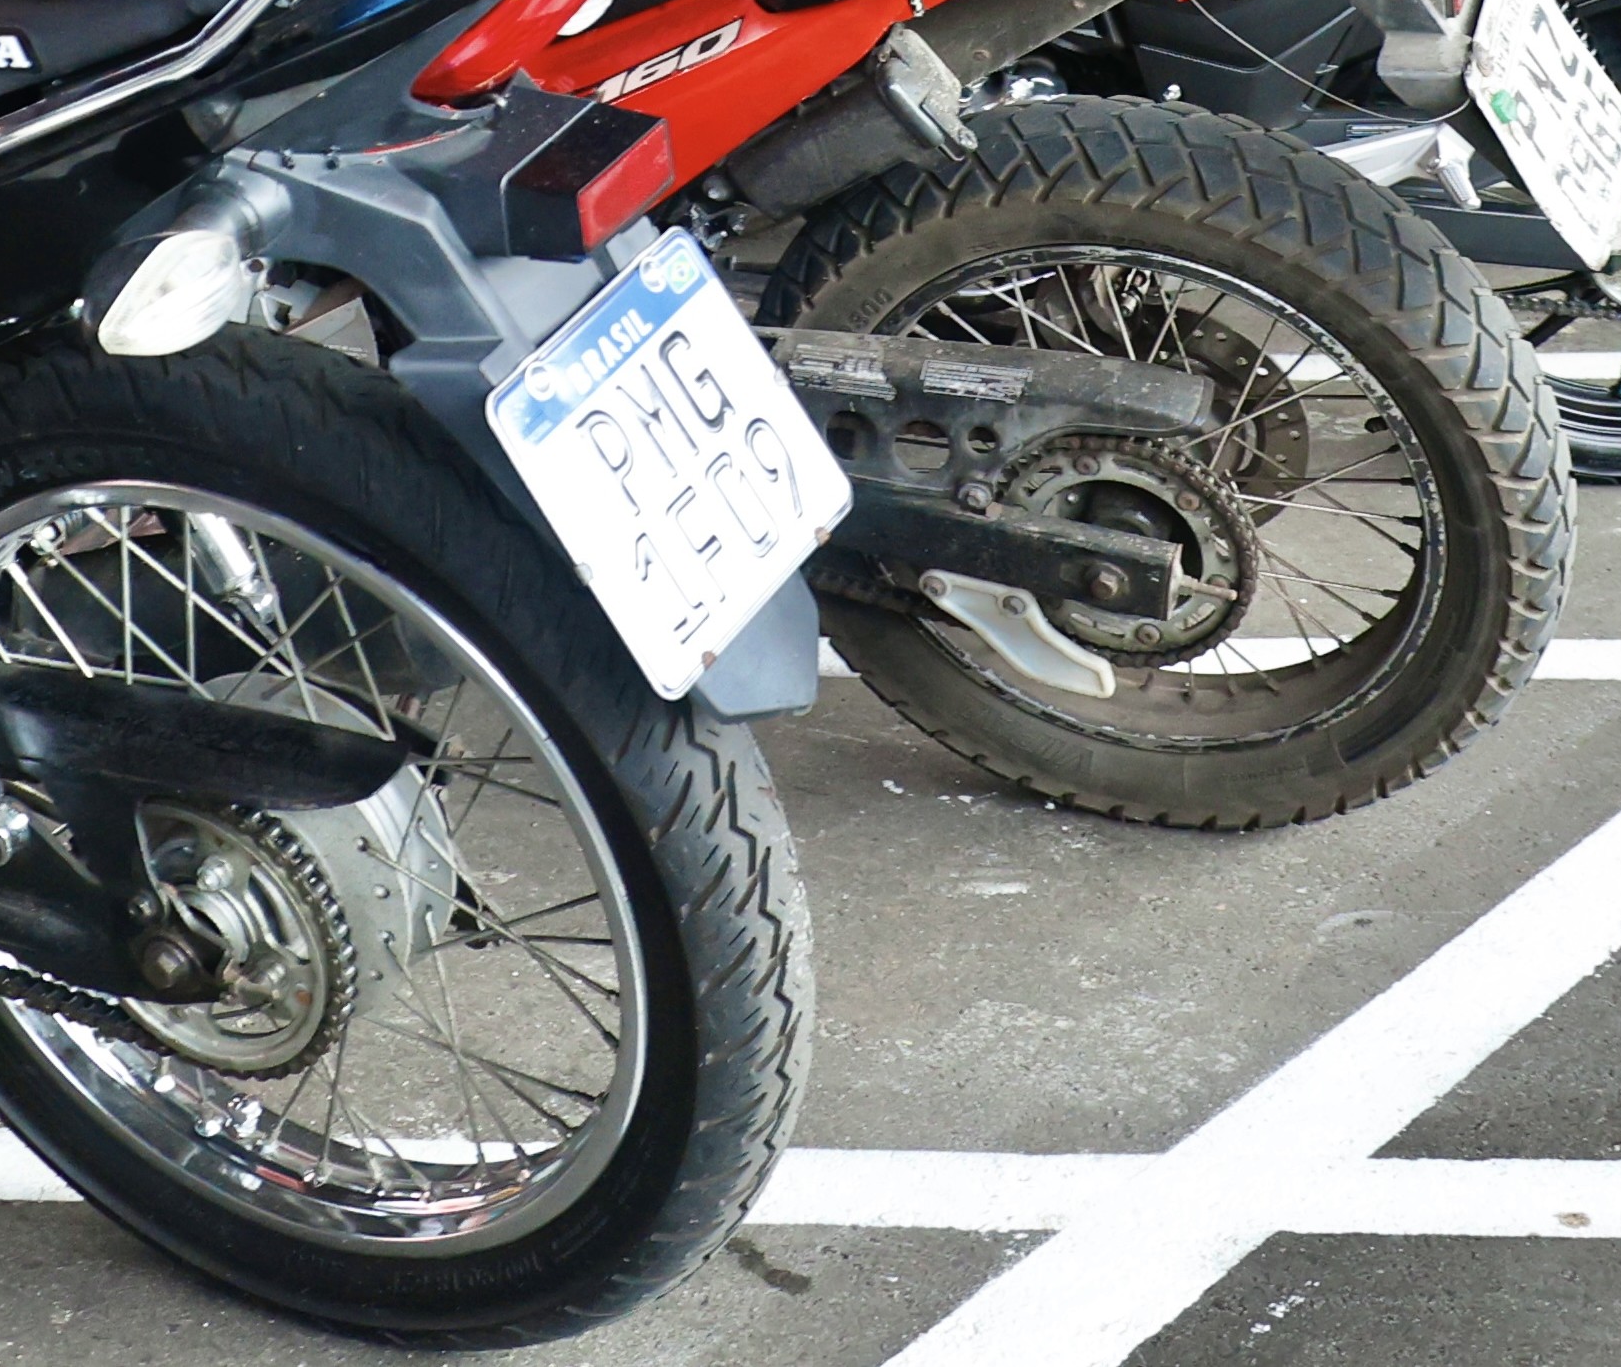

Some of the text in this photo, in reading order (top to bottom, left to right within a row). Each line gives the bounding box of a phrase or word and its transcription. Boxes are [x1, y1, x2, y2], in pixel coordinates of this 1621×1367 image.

[596, 18, 745, 104] 160
[568, 308, 654, 397] BRASIL
[575, 329, 736, 518] PMG
[635, 416, 804, 645] 1F09
